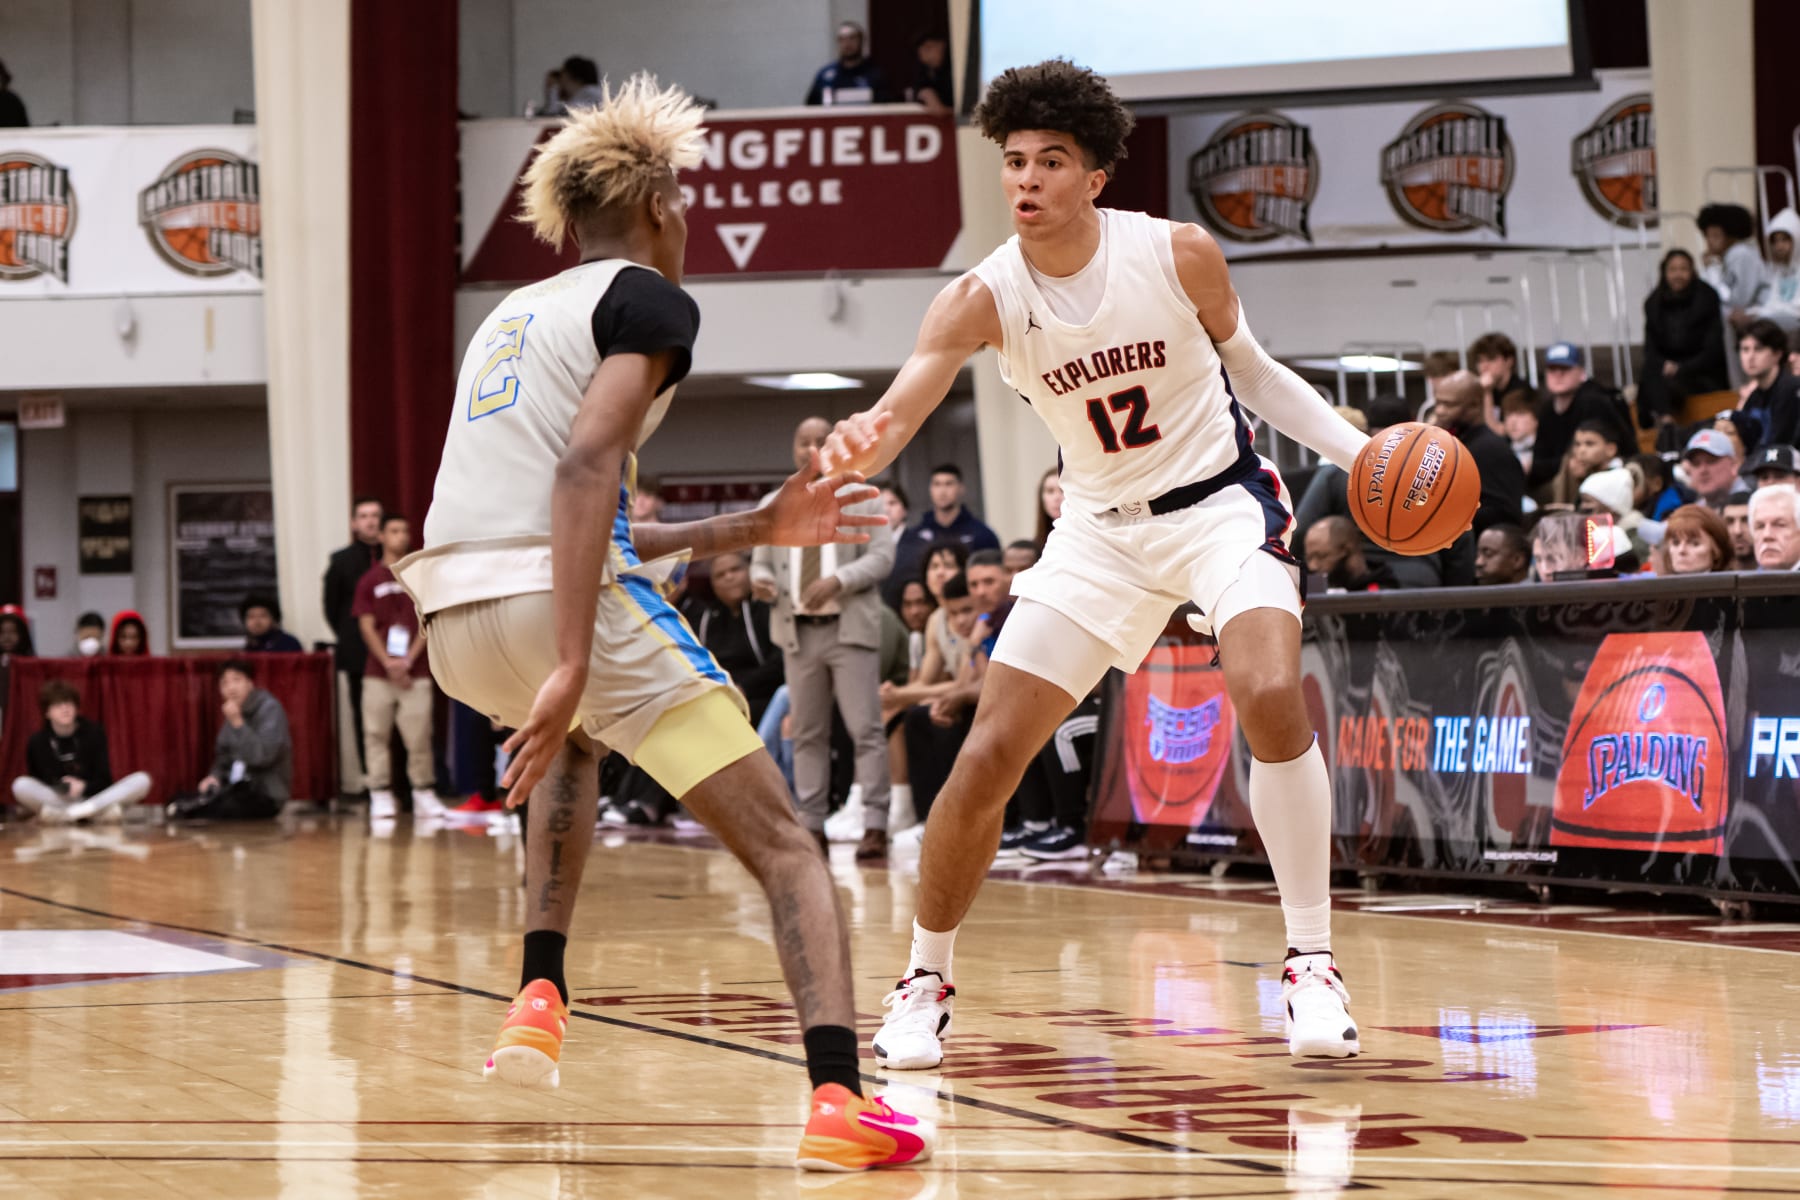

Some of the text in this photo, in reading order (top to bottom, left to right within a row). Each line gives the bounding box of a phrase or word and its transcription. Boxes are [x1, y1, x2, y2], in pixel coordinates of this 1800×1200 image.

[468, 313, 535, 422] 2
[1042, 340, 1166, 396] EXPLORERS
[1086, 385, 1162, 453] 12
[1367, 427, 1414, 507] SPALDING
[1402, 438, 1440, 512] PRECISION
[1337, 716, 1532, 773] MADE FOR THE GAME.
[1582, 731, 1709, 813] SPALDING
